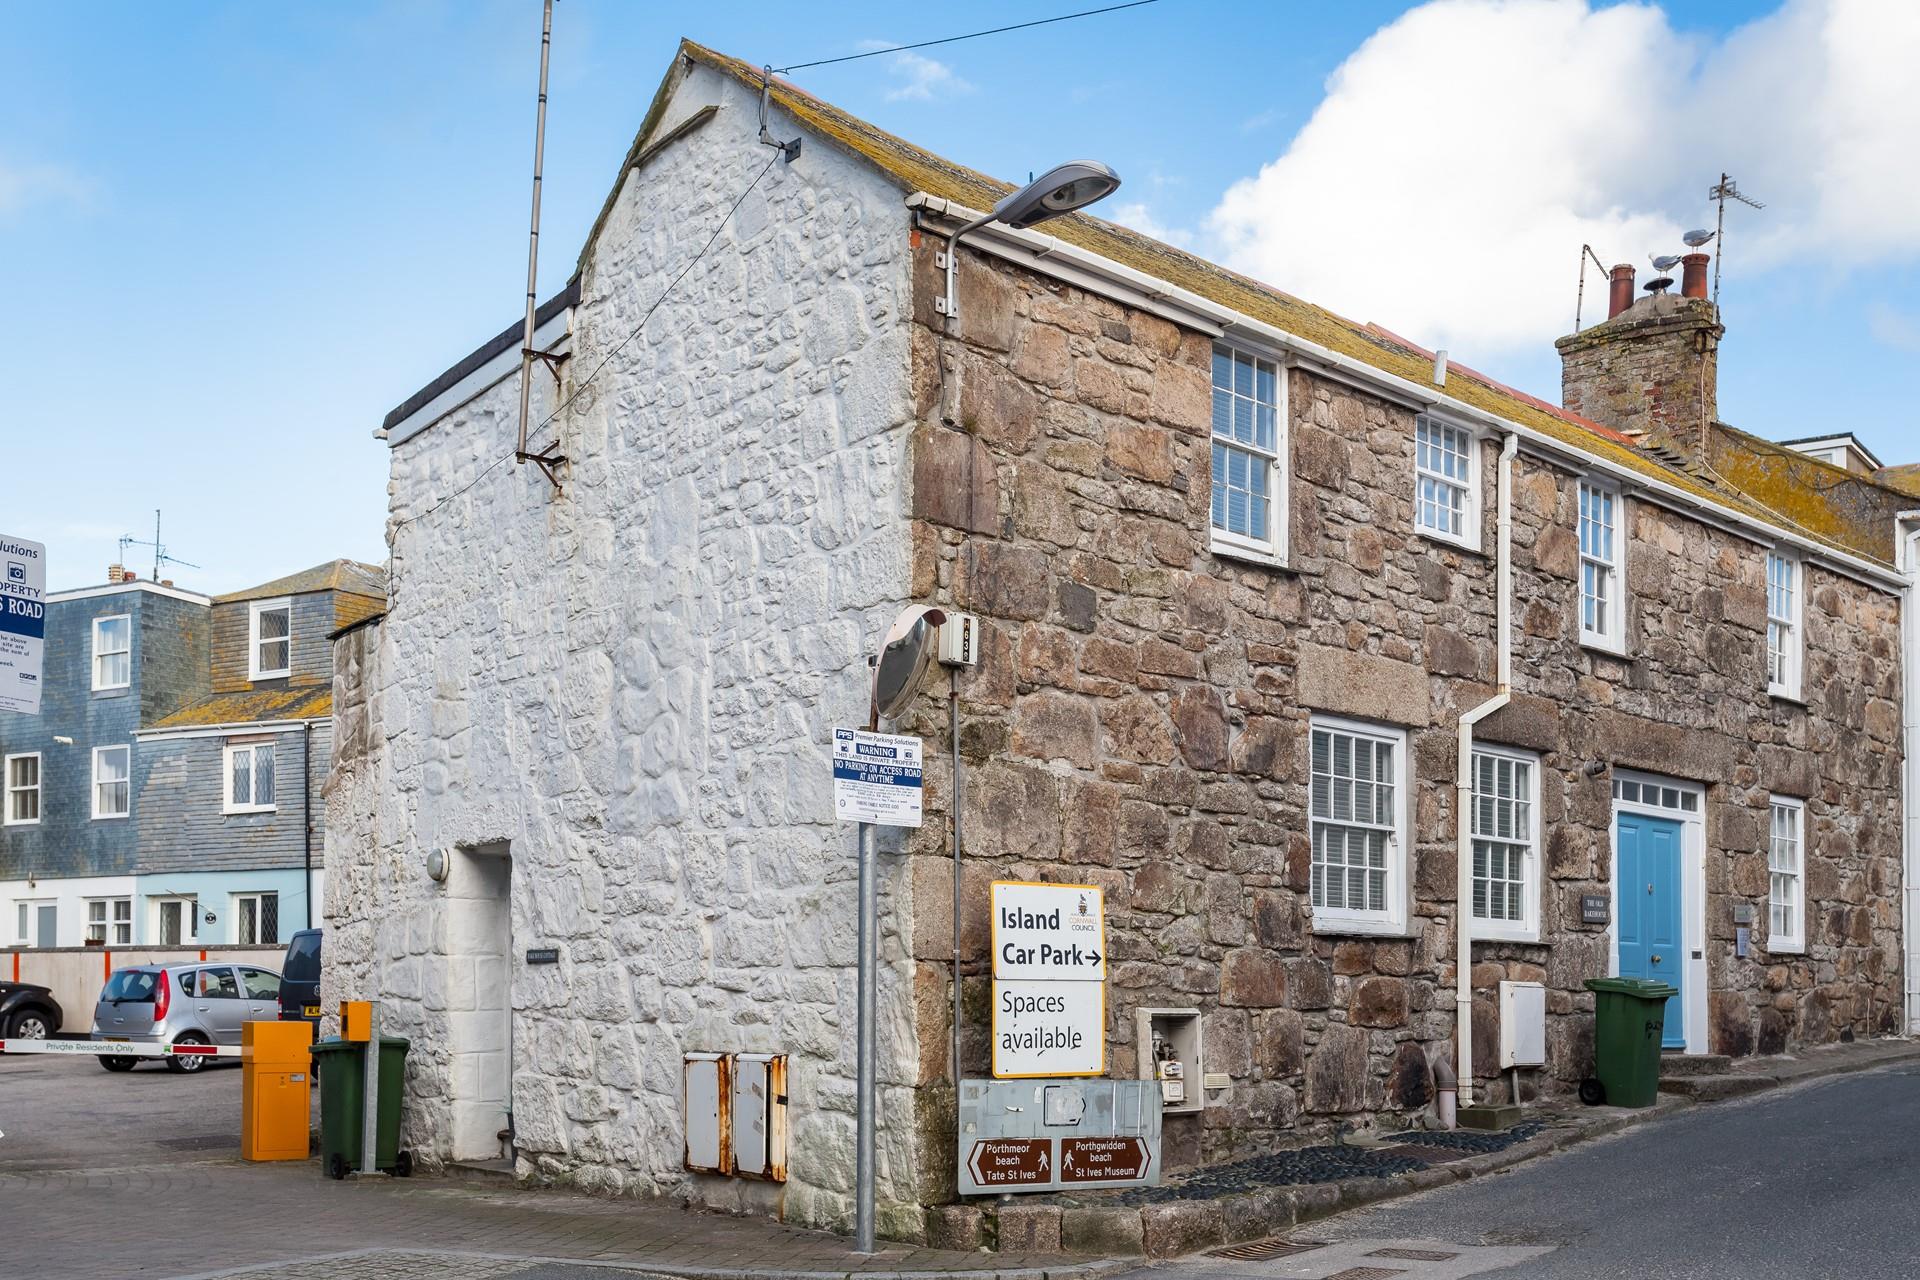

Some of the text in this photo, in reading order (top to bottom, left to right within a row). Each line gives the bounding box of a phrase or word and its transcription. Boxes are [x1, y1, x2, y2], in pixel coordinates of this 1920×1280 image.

[8, 598, 43, 619] ROAD
[837, 730, 919, 747] PPS Premier Parking Solutions
[859, 745, 894, 757] WARNING
[835, 751, 848, 759] THIS
[869, 756, 889, 764] PRIVATE
[892, 759, 920, 767] PROPERTY
[834, 759, 922, 778] NO PARKING ON ACCESS ROAD
[859, 772, 894, 784] AT ANYTIME
[1002, 907, 1060, 930] Island
[1002, 943, 1084, 966] Car Park
[1002, 990, 1065, 1018] Spaces
[1002, 1026, 1082, 1050] available
[46, 1042, 134, 1053] Private Residents Only
[986, 1143, 1031, 1155] Porthmeor
[1075, 1141, 1126, 1153] Porthgwidden
[995, 1155, 1020, 1166] beach
[1090, 1151, 1112, 1162] beach
[986, 1169, 1037, 1181] Tate St Ives
[1075, 1165, 1135, 1177] St Ives Museum
